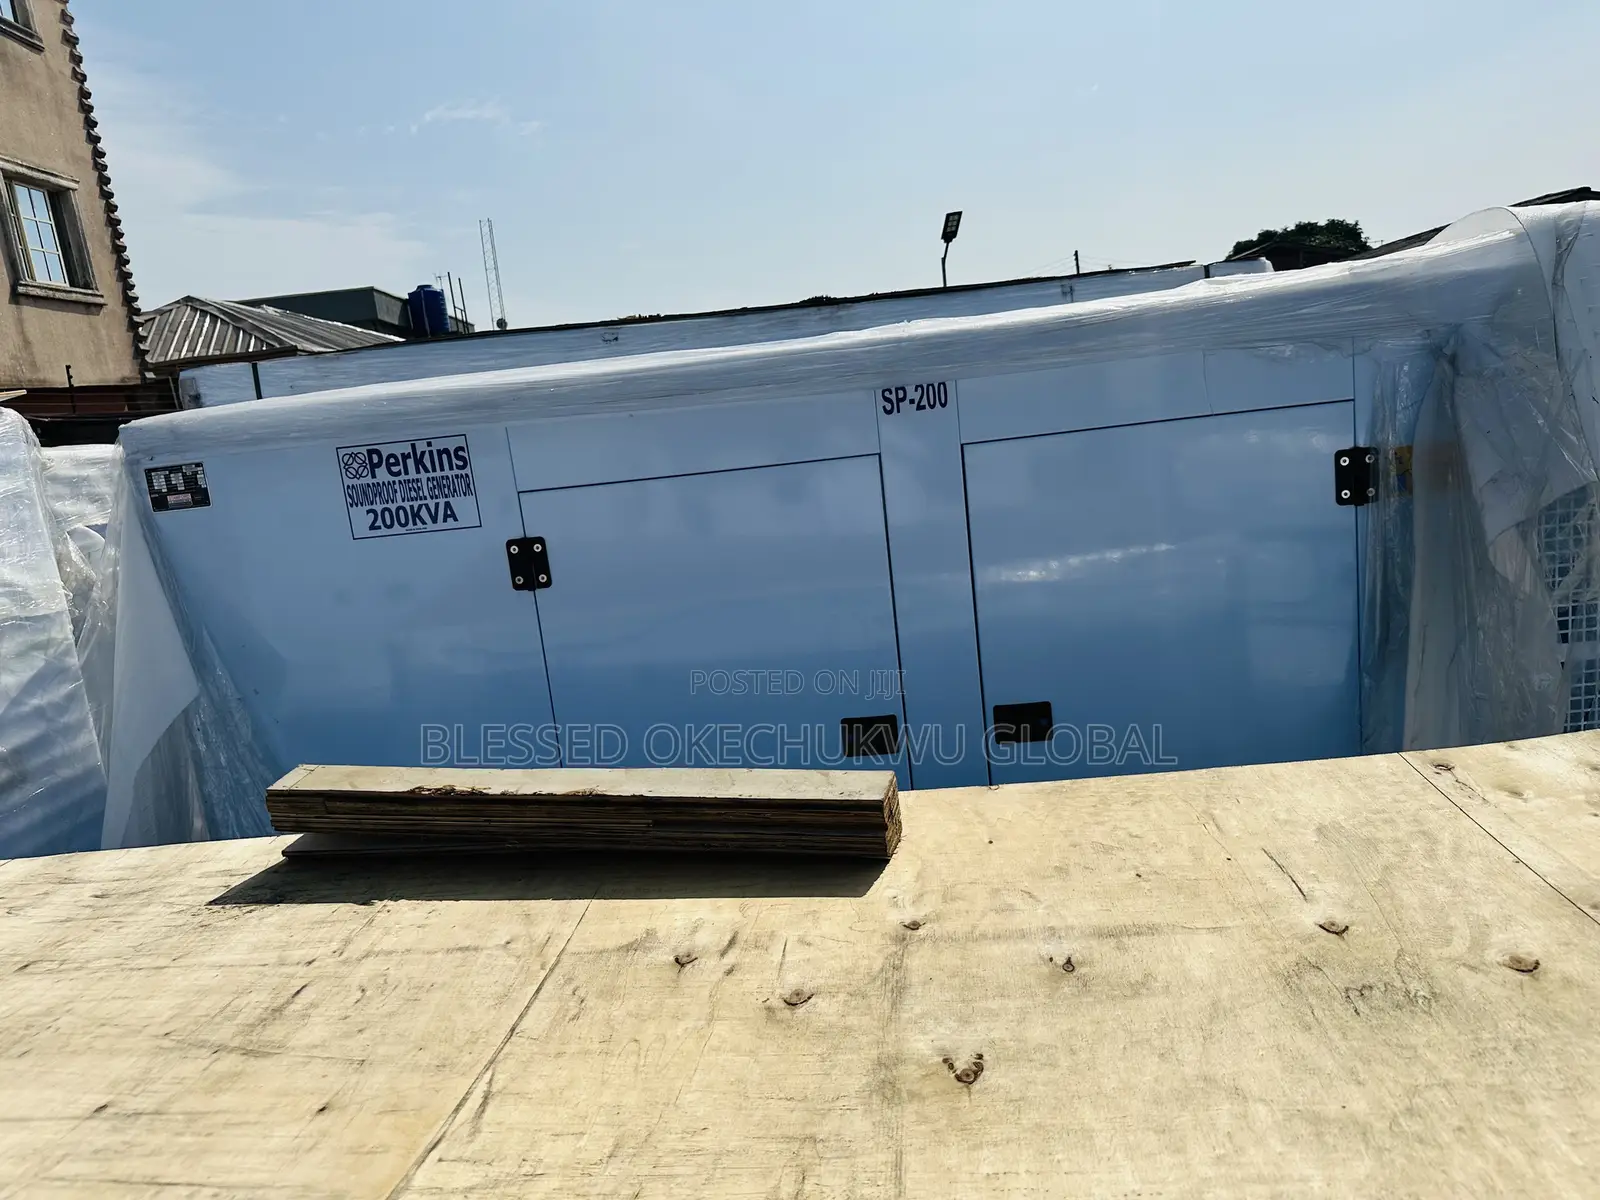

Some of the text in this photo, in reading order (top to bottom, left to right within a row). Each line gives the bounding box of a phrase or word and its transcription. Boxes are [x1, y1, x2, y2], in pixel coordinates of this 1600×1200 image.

[881, 382, 948, 415] SP-200
[366, 441, 469, 479] Perkins
[346, 473, 474, 508] SOUNDPROOF DIESEL GENERATOR
[366, 500, 459, 531] 200KVA
